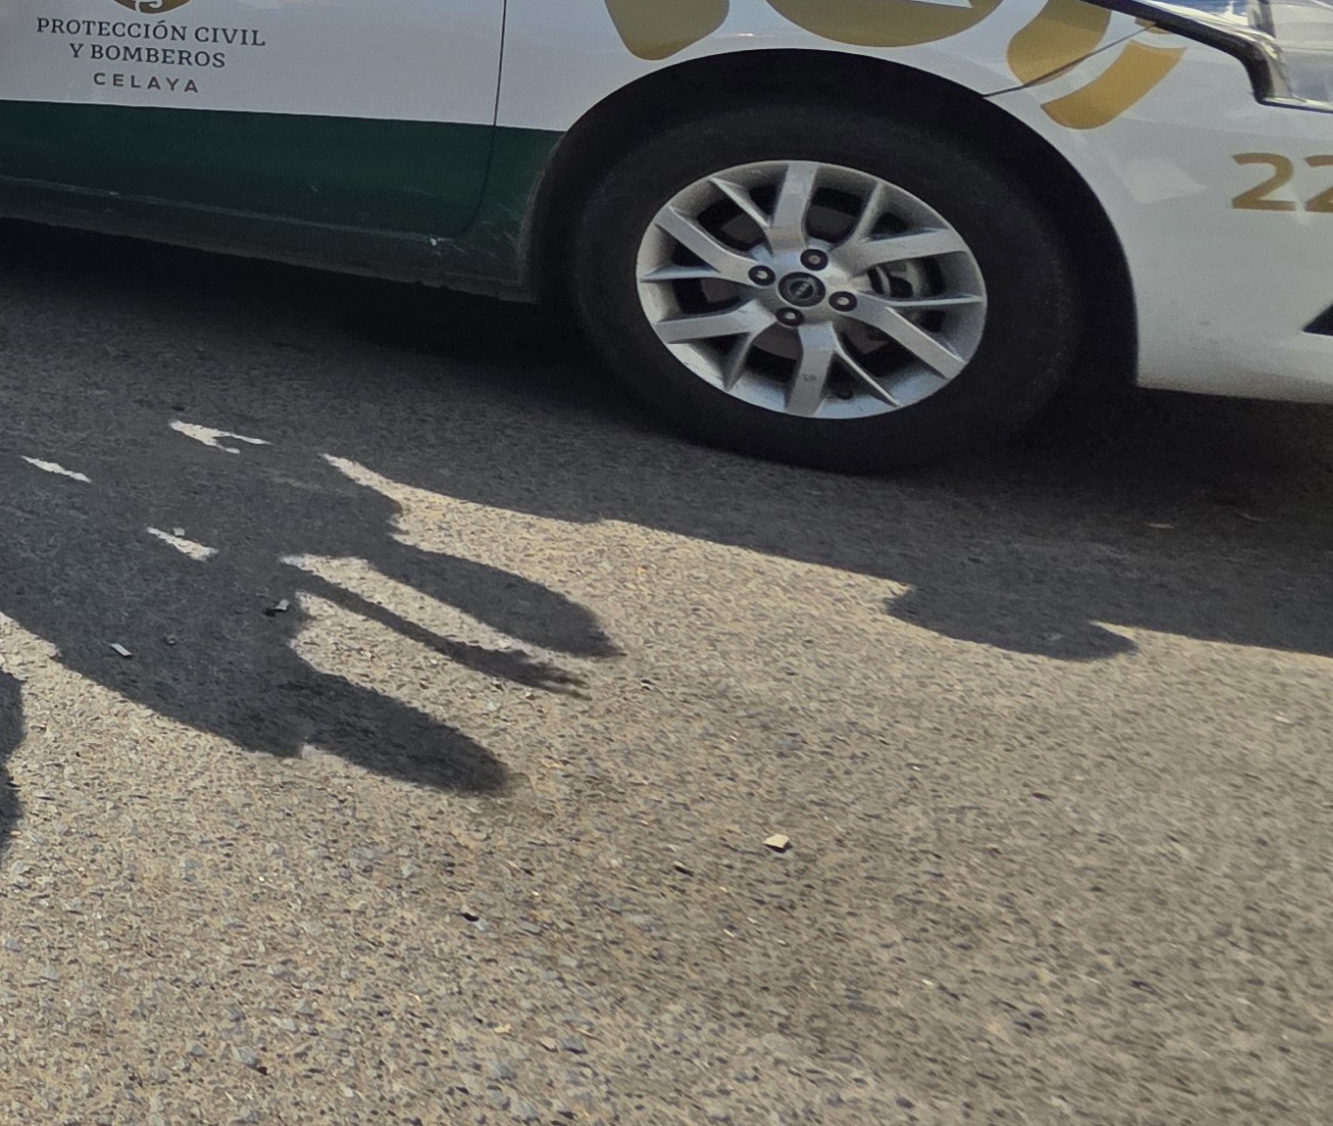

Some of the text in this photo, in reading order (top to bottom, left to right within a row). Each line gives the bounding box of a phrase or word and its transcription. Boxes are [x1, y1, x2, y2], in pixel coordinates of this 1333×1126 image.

[36, 17, 267, 47] PROTECCIÓN CIVIL
[69, 42, 226, 69] Y BOMBEROS
[93, 72, 199, 94] CELAYA
